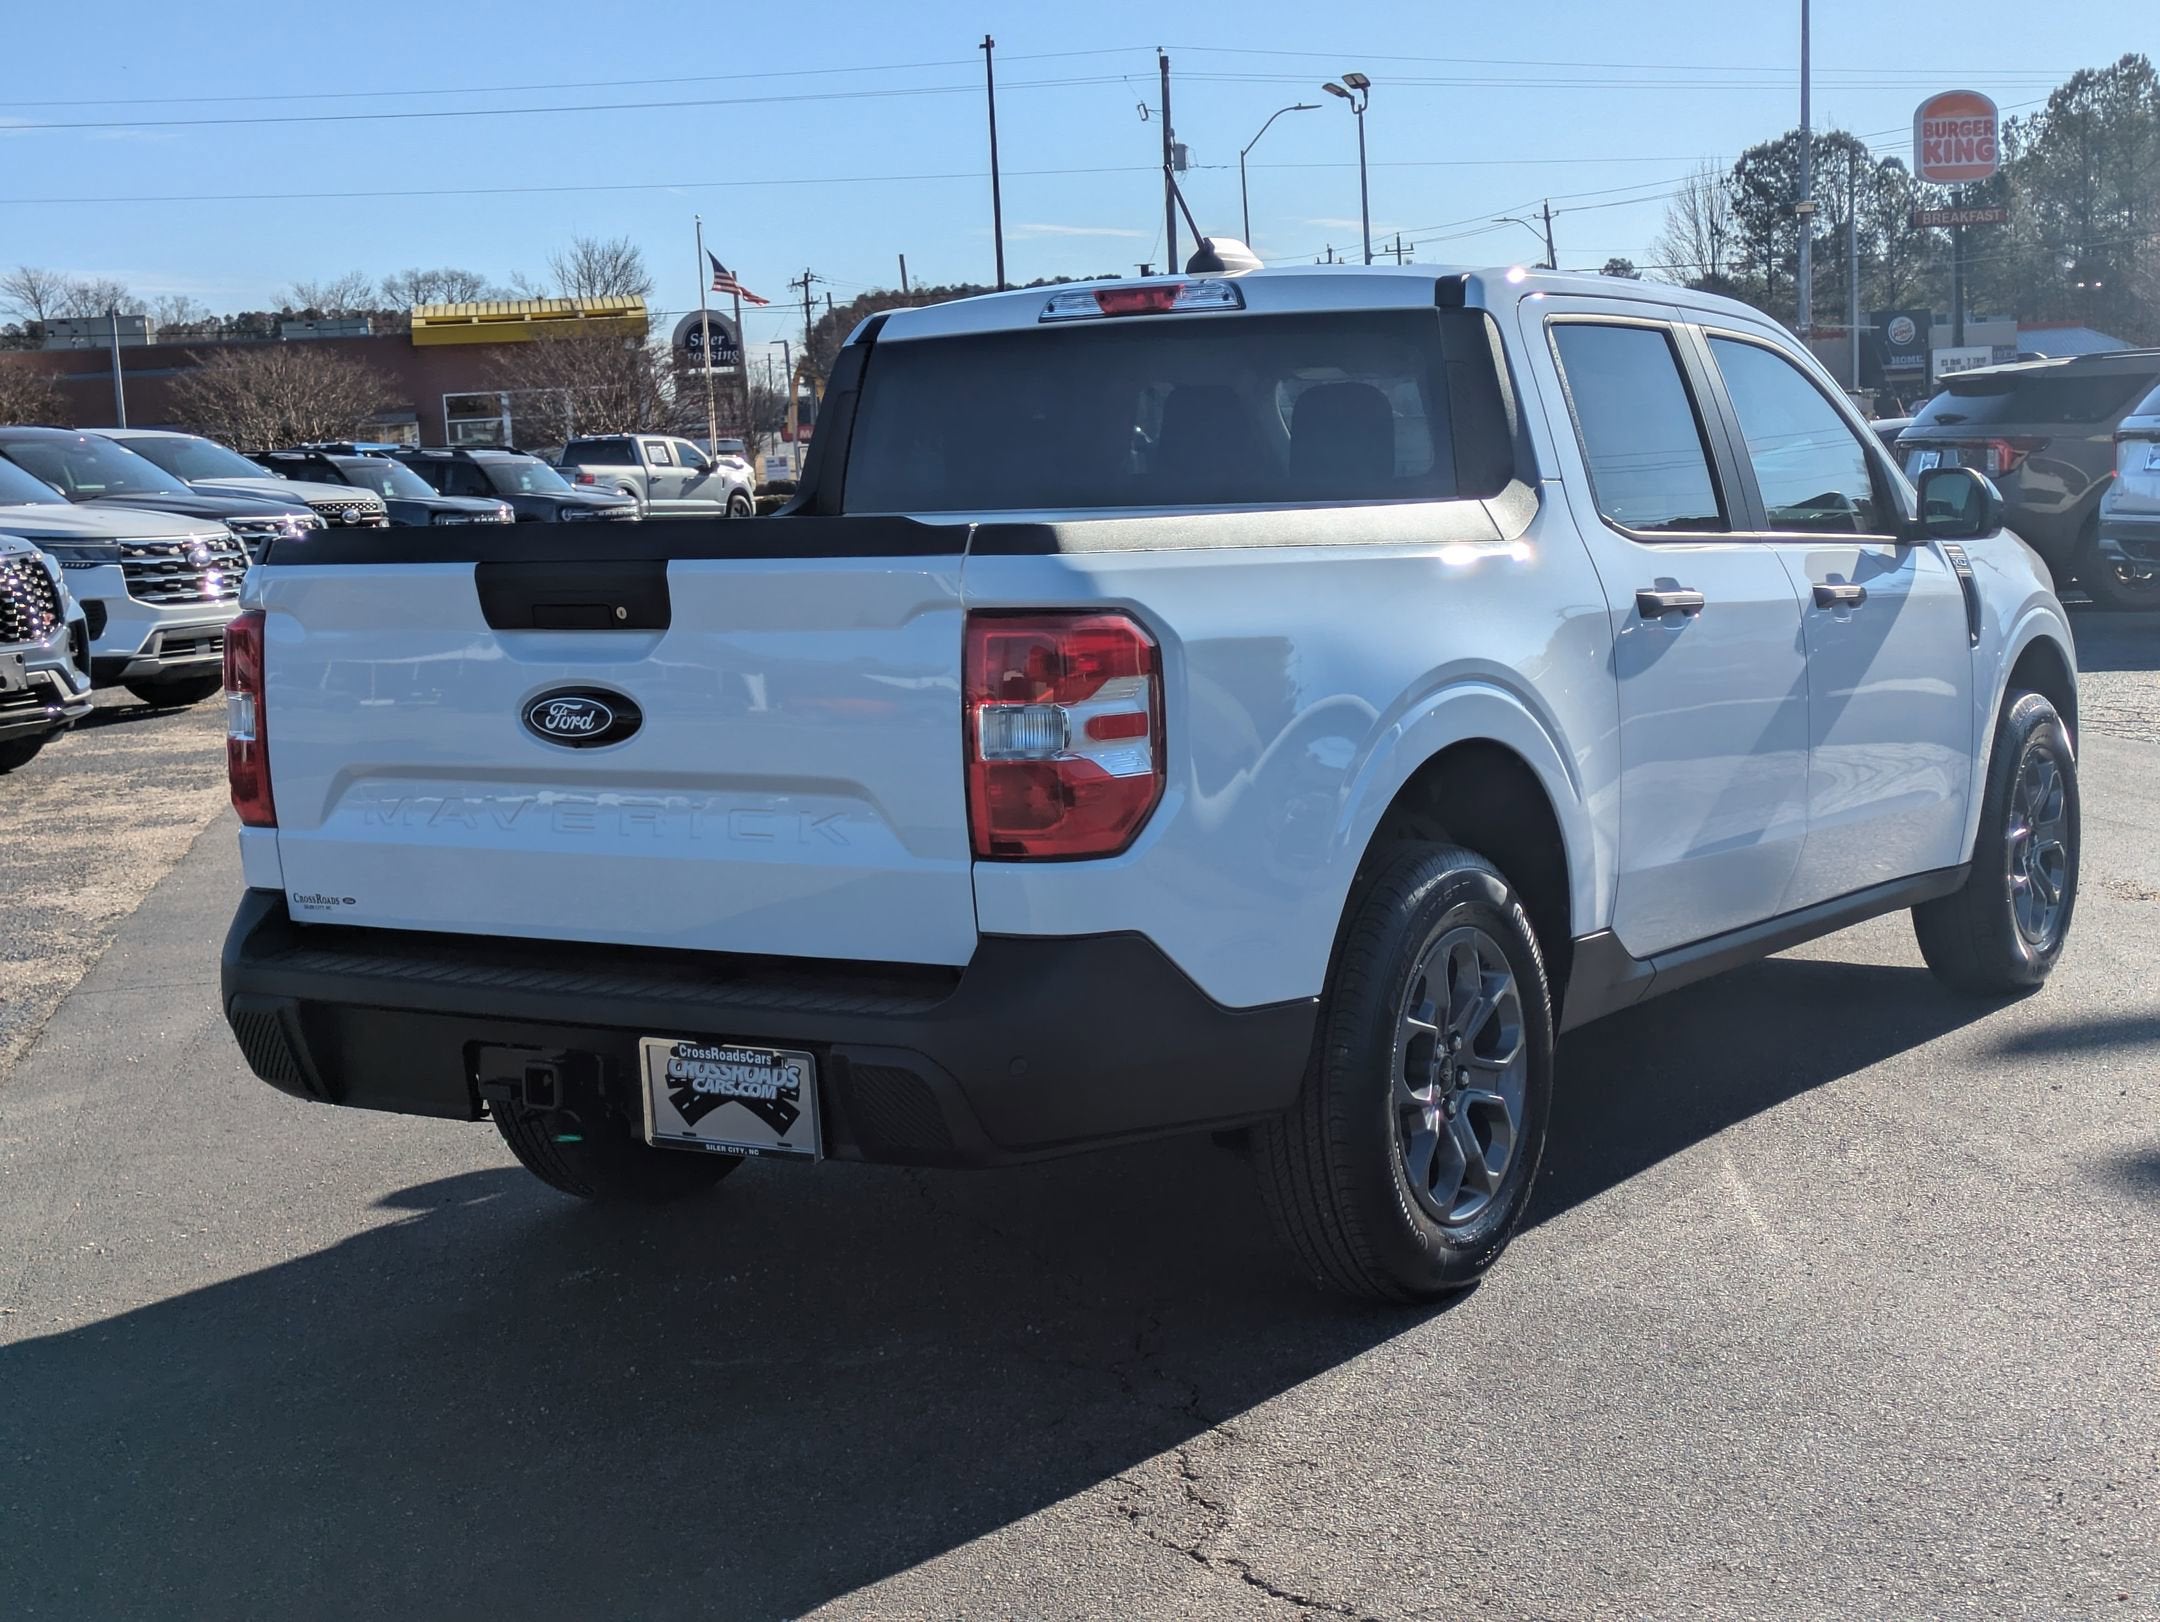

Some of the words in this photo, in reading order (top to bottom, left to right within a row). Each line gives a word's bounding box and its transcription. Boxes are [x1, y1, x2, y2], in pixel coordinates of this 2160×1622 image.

[1922, 119, 1995, 139] BURGER
[1922, 138, 1996, 164] KING
[1922, 209, 2001, 225] BREAKFAST
[689, 332, 726, 347] Sier
[686, 348, 740, 364] rossing
[545, 702, 596, 730] Ford
[363, 797, 851, 847] MAVERICK
[678, 1044, 772, 1065] CrossRoadsCars
[668, 1059, 801, 1089] CROSSROADS
[692, 1077, 778, 1100] CARS.COM
[705, 1143, 726, 1153] SILER
[748, 1148, 760, 1156] NC
